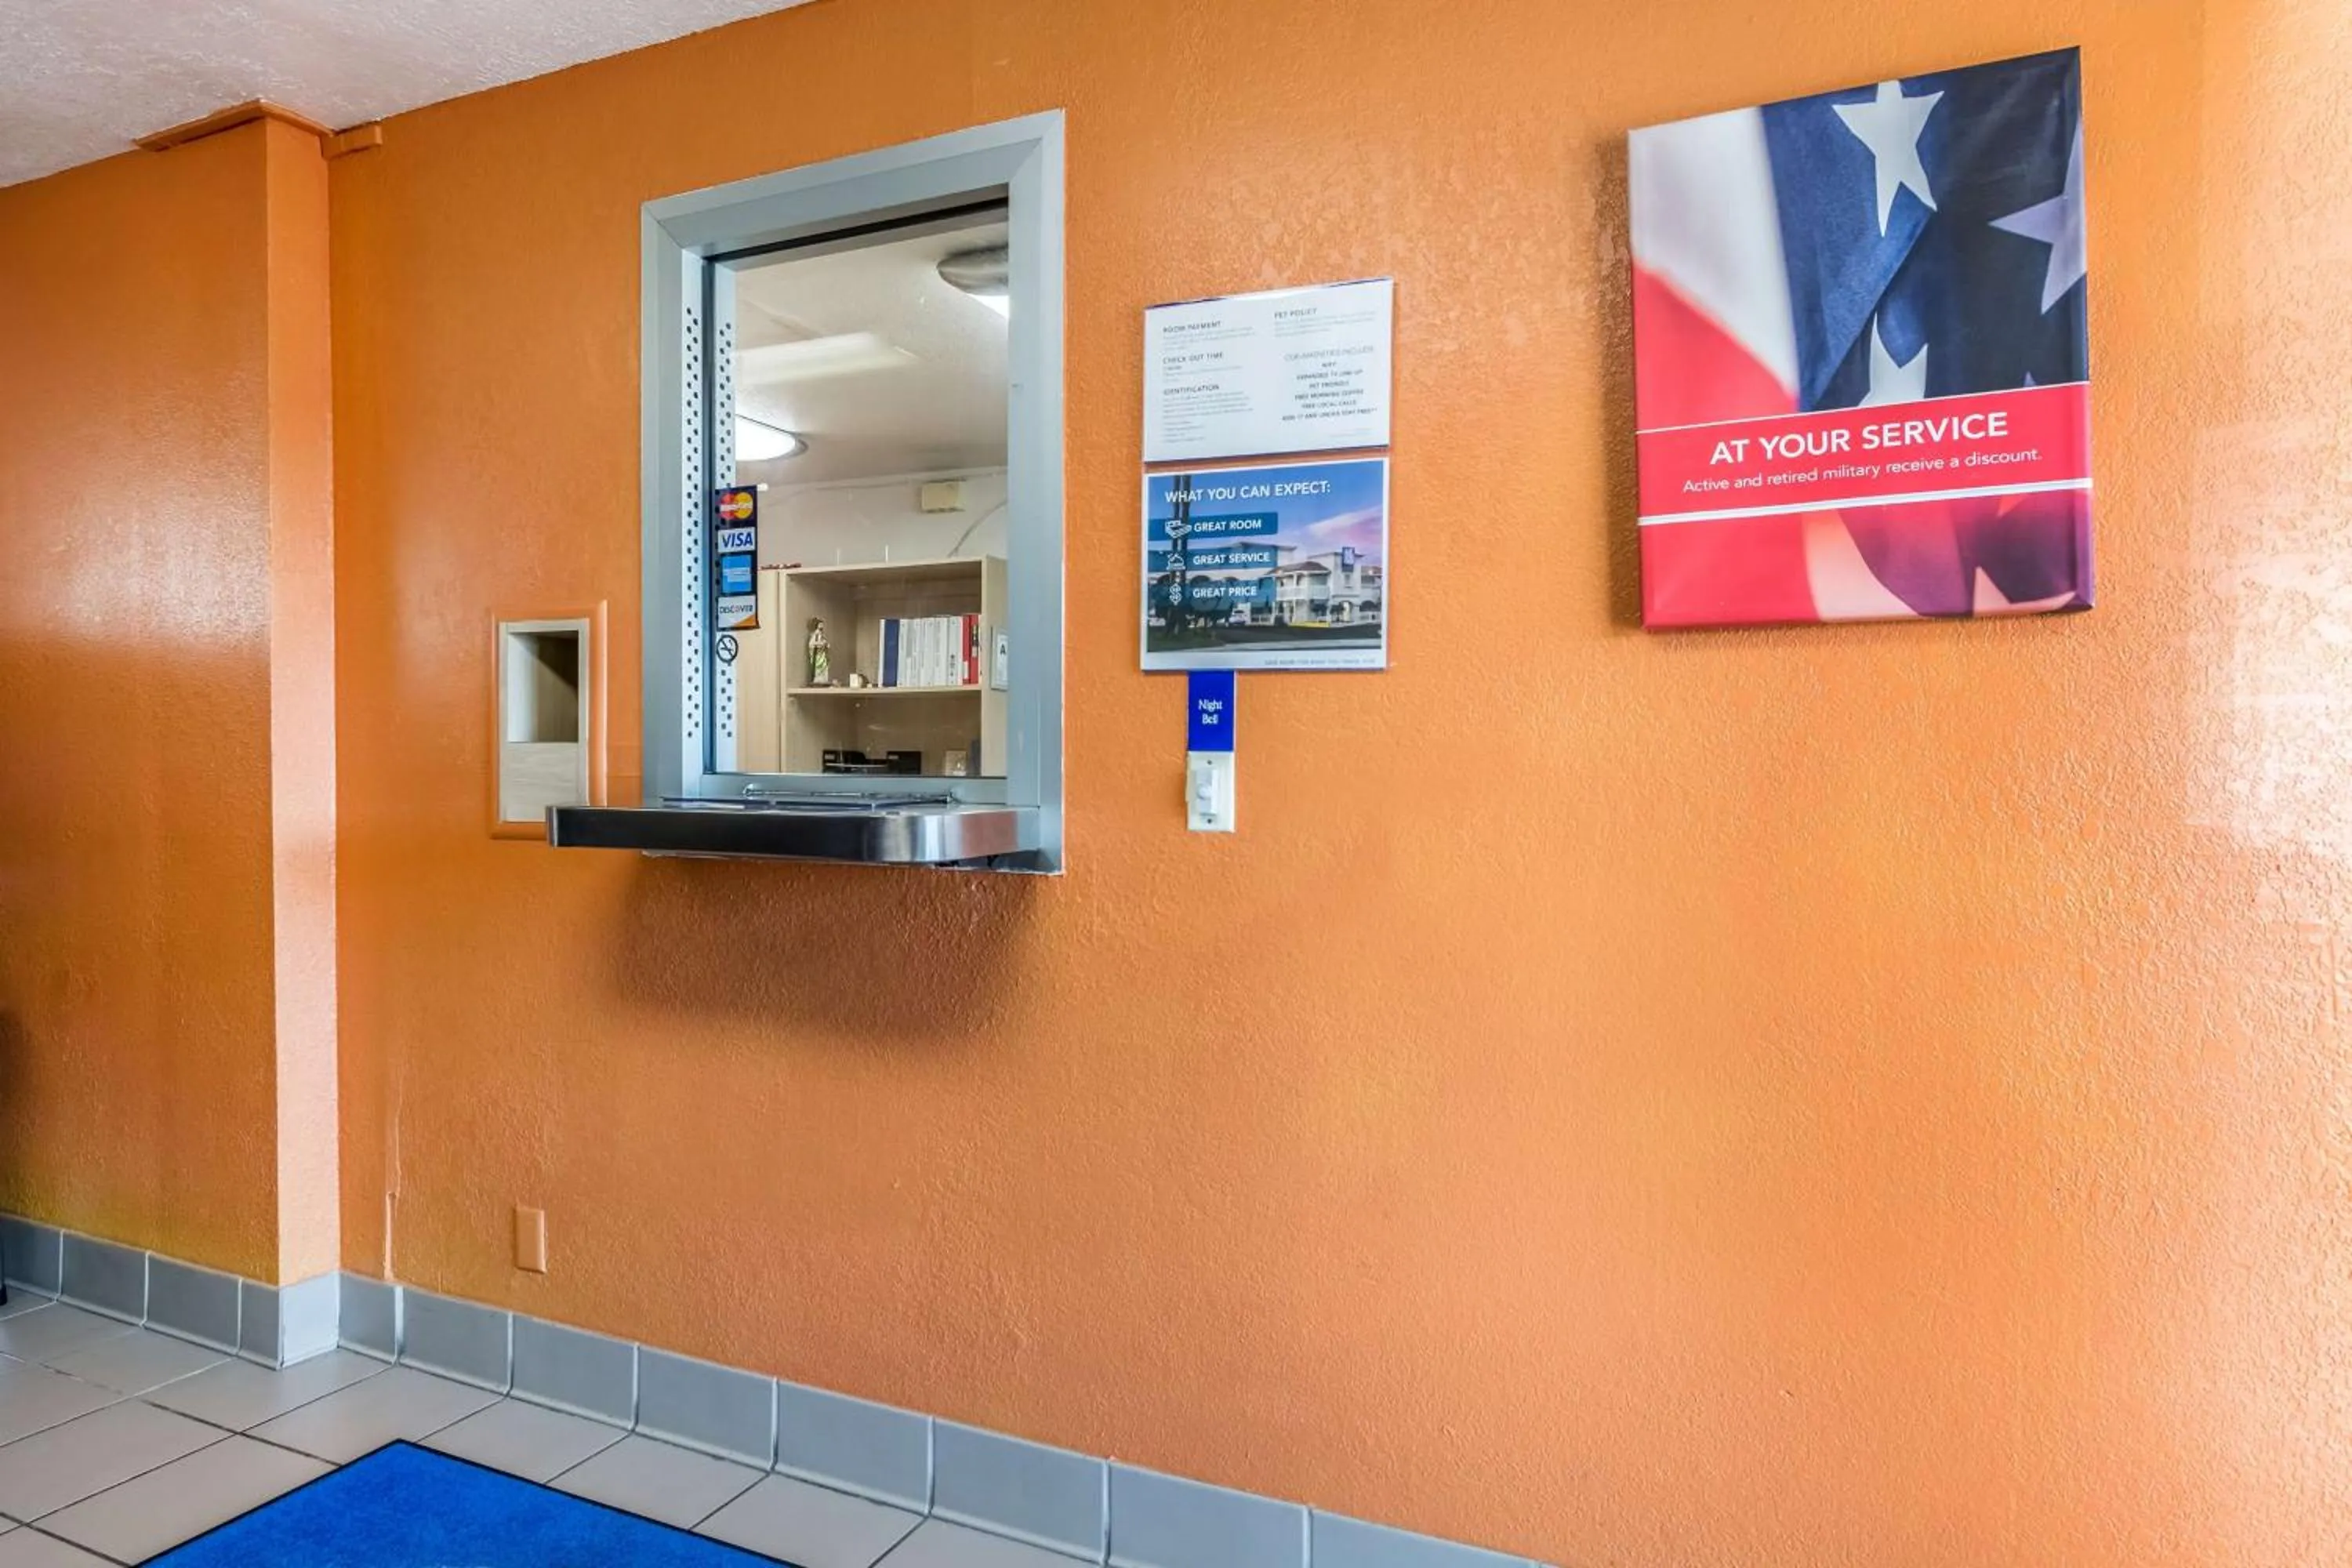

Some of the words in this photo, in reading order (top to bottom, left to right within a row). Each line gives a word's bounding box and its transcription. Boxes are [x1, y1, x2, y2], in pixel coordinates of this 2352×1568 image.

[1188, 320, 1221, 330] PAYMENT
[1163, 356, 1186, 365] CHECK
[1189, 353, 1203, 362] OUT
[1207, 350, 1223, 359] TIME
[1163, 383, 1220, 396] IDENTIFICATION
[1710, 438, 1750, 465] AT
[1759, 429, 1851, 460] YOUR
[1862, 411, 2009, 450] SERVICE
[1683, 478, 1730, 493] Active
[1733, 473, 1762, 489] and
[1767, 467, 1819, 485] retired
[1823, 463, 1881, 480] military
[1886, 457, 1945, 474] receive
[1950, 457, 1960, 468] a
[1965, 448, 2043, 467] discount.
[1165, 488, 1203, 503] WHAT
[1208, 487, 1236, 501] YOU
[1240, 485, 1271, 499] CAN
[1276, 480, 1331, 497] EXPECT:
[1194, 521, 1227, 532] GREAT
[1229, 519, 1262, 530] ROOM
[722, 532, 753, 547] VISA
[1193, 554, 1226, 564] GREAT
[1229, 551, 1271, 563] SERVICE
[1193, 587, 1226, 597] GREAT
[1229, 586, 1258, 596] PRICE
[720, 604, 753, 614] DISCOVER
[1198, 699, 1223, 712] Night
[1202, 713, 1219, 725] Bell
